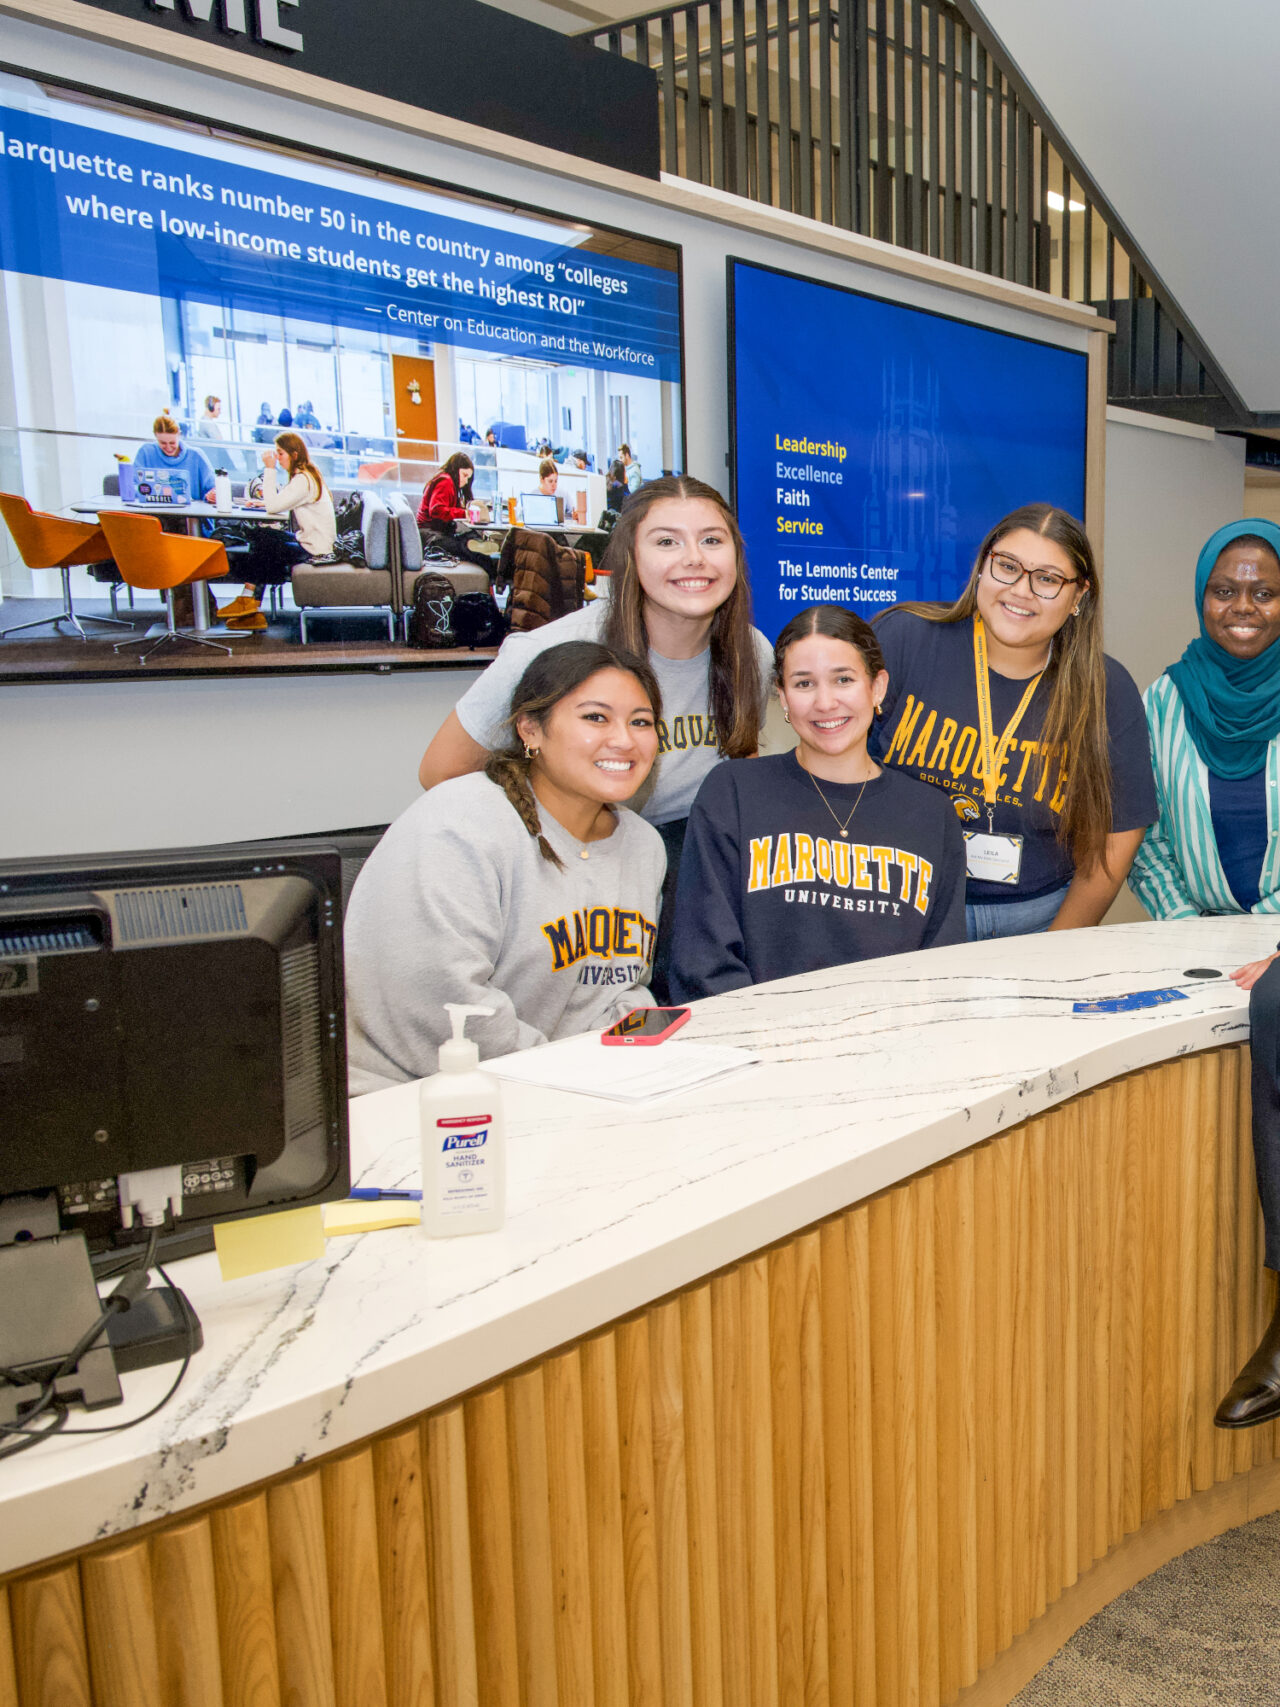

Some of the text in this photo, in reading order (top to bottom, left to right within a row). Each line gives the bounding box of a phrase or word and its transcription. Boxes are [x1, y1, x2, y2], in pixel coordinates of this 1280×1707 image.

[141, 168, 214, 201] ranks
[221, 187, 314, 223] number
[320, 207, 346, 230] 50
[350, 213, 371, 237] in
[376, 220, 411, 246] the
[416, 233, 490, 265] country
[494, 253, 555, 282] among
[558, 263, 629, 295] “colleges
[66, 194, 585, 316] where low-income students get the highest ROI”
[386, 304, 438, 328] Center
[444, 318, 463, 333] on
[467, 319, 537, 346] Education
[540, 333, 565, 352] and
[568, 335, 590, 355] the
[592, 341, 655, 366] Workforce
[775, 433, 847, 463] Leadership
[776, 462, 843, 485] Excellence
[776, 488, 810, 507] Faith
[776, 516, 824, 535] Service
[778, 560, 899, 581] The Lemonis Center
[778, 583, 897, 602] for Student Success
[920, 772, 1018, 806] GOLDEN EALES
[747, 832, 934, 916] MARQUETTE
[784, 888, 900, 916] UNIVERSITY
[446, 1133, 485, 1149] Purell
[445, 1158, 485, 1168] SANITIZER
[453, 1153, 477, 1161] HAND
